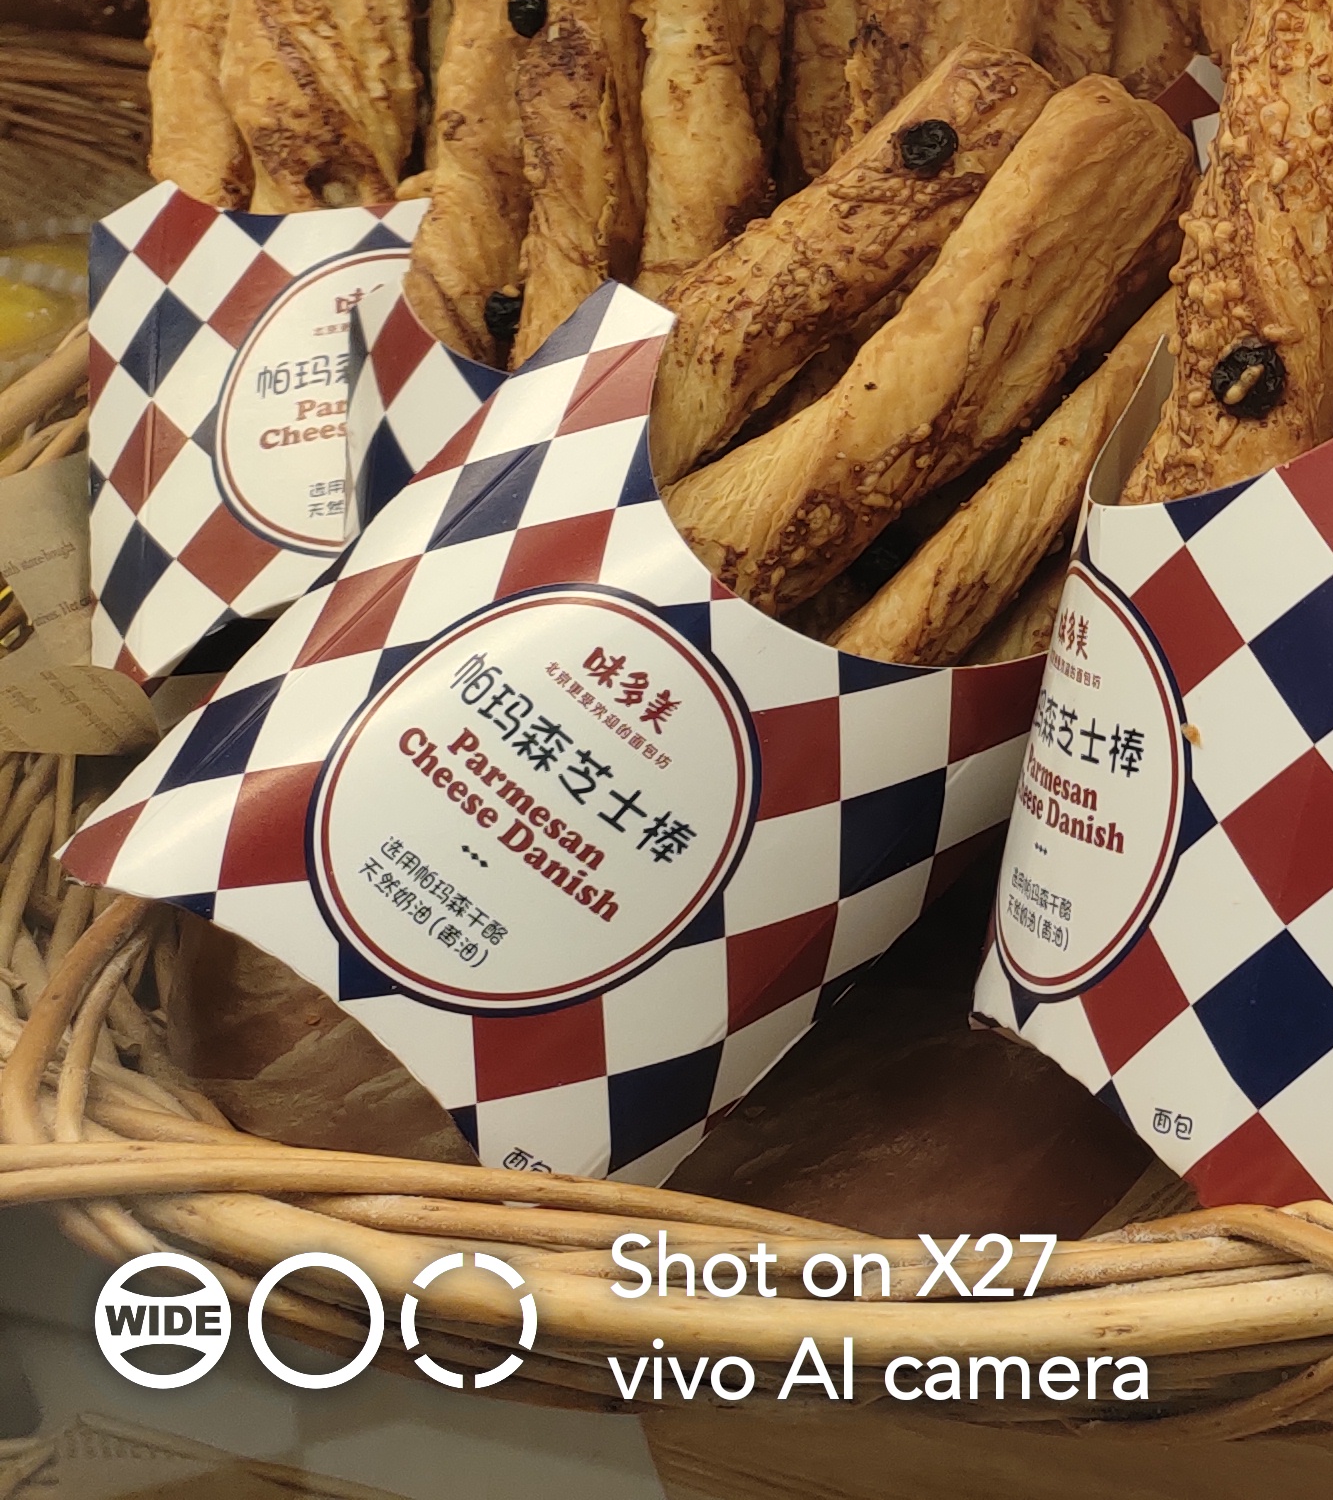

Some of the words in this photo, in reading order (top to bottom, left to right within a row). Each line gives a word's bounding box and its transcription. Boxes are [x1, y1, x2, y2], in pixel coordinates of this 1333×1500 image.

[545, 661, 673, 770] 北京更受欢迎的面包坊
[582, 646, 683, 735] 味多美
[446, 727, 607, 871] Parmesan
[449, 652, 698, 864] 帕玛森芝士棒
[1026, 743, 1098, 812] Parmesan
[398, 727, 500, 830] Cheese
[496, 817, 621, 923] Danish
[1045, 797, 1125, 854] Danish
[380, 836, 510, 946] 选用帕玛森干酪
[1152, 1107, 1193, 1140] 面包
